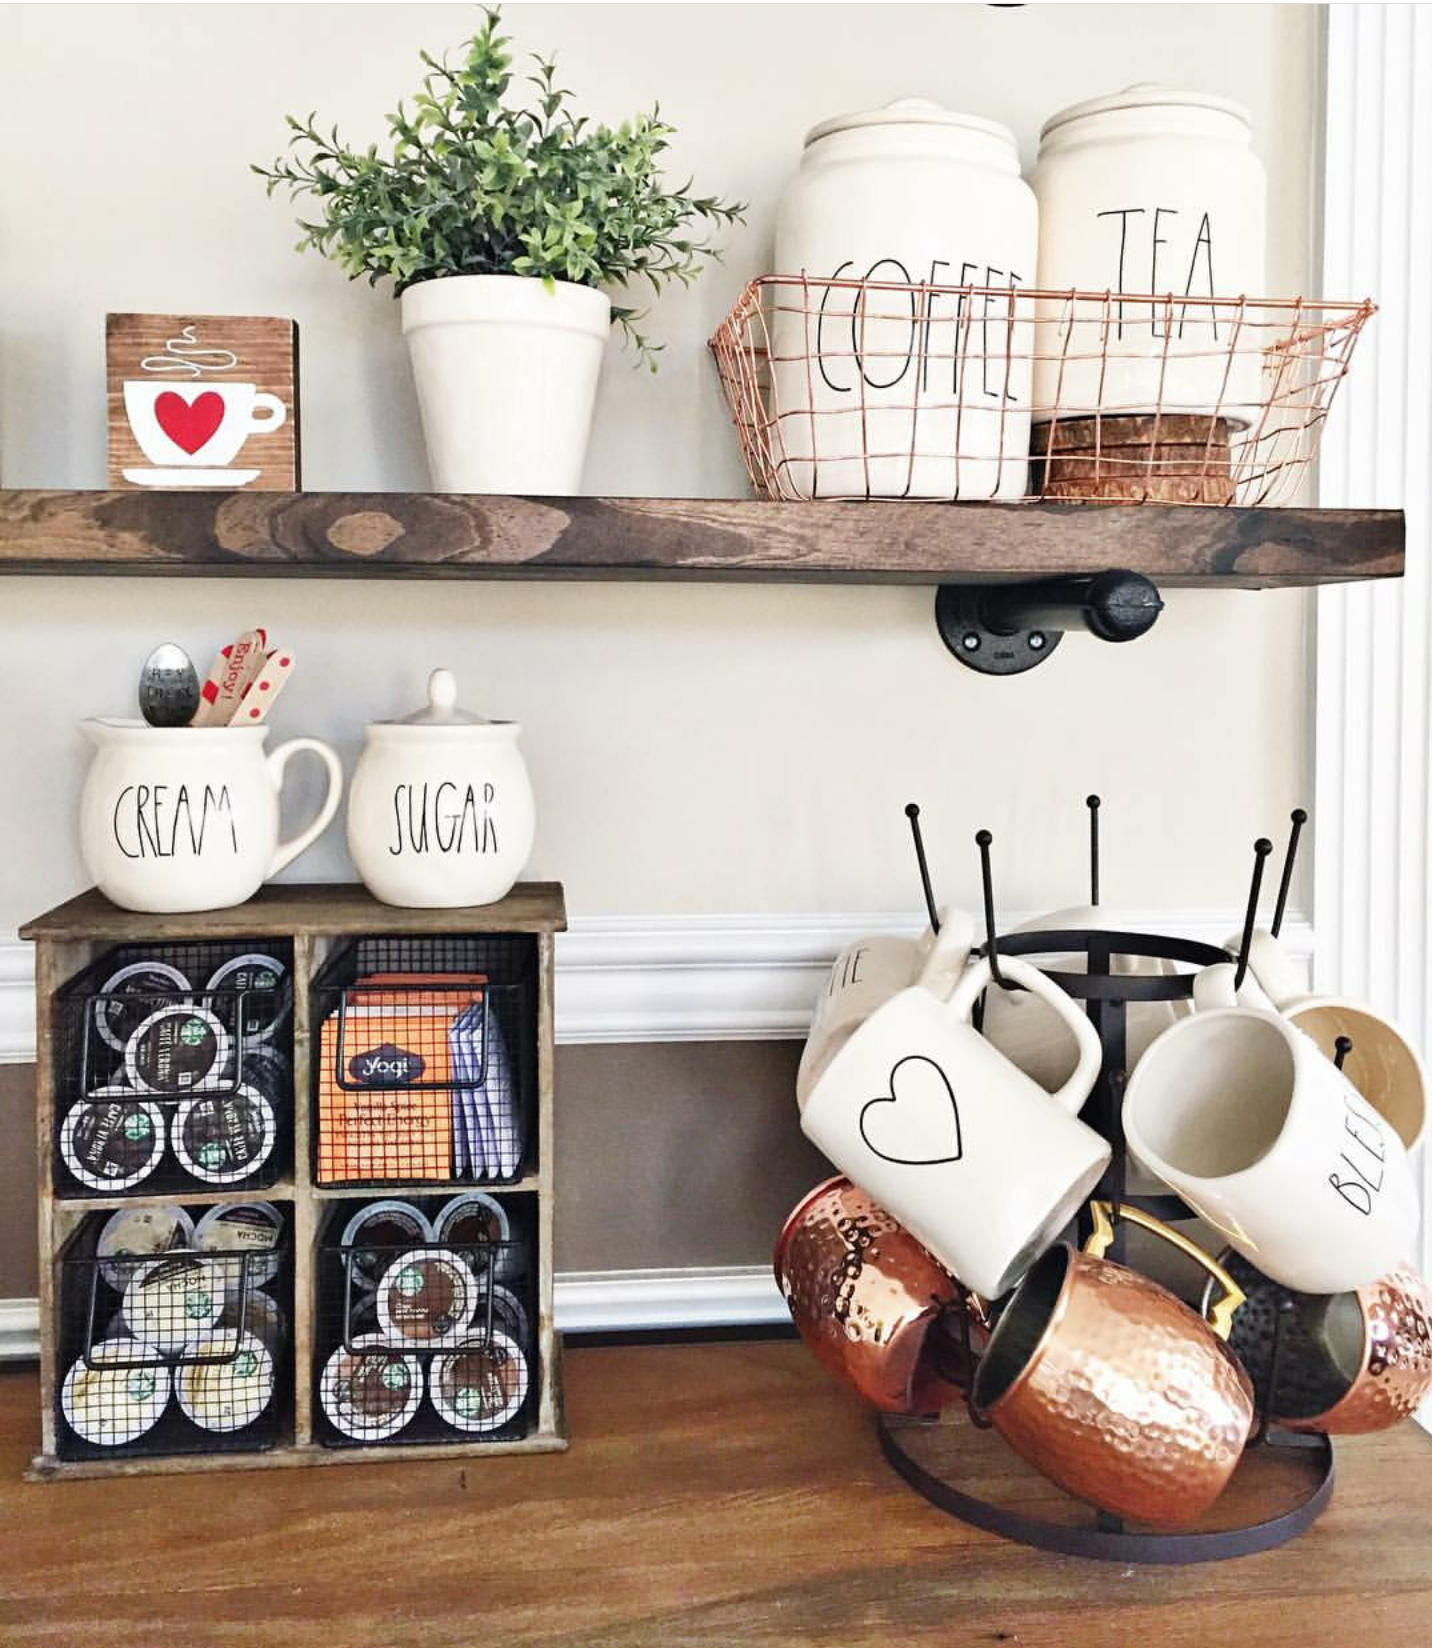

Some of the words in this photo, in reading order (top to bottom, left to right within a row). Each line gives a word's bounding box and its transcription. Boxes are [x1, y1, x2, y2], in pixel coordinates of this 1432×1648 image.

[1097, 207, 1218, 342] TEA
[817, 258, 1023, 402] COFFEE
[221, 643, 250, 699] Enjoy!
[114, 784, 238, 858] CREAM
[389, 782, 499, 857] SUGAR
[362, 1057, 410, 1078] yogi
[237, 1230, 273, 1243] MOCHA
